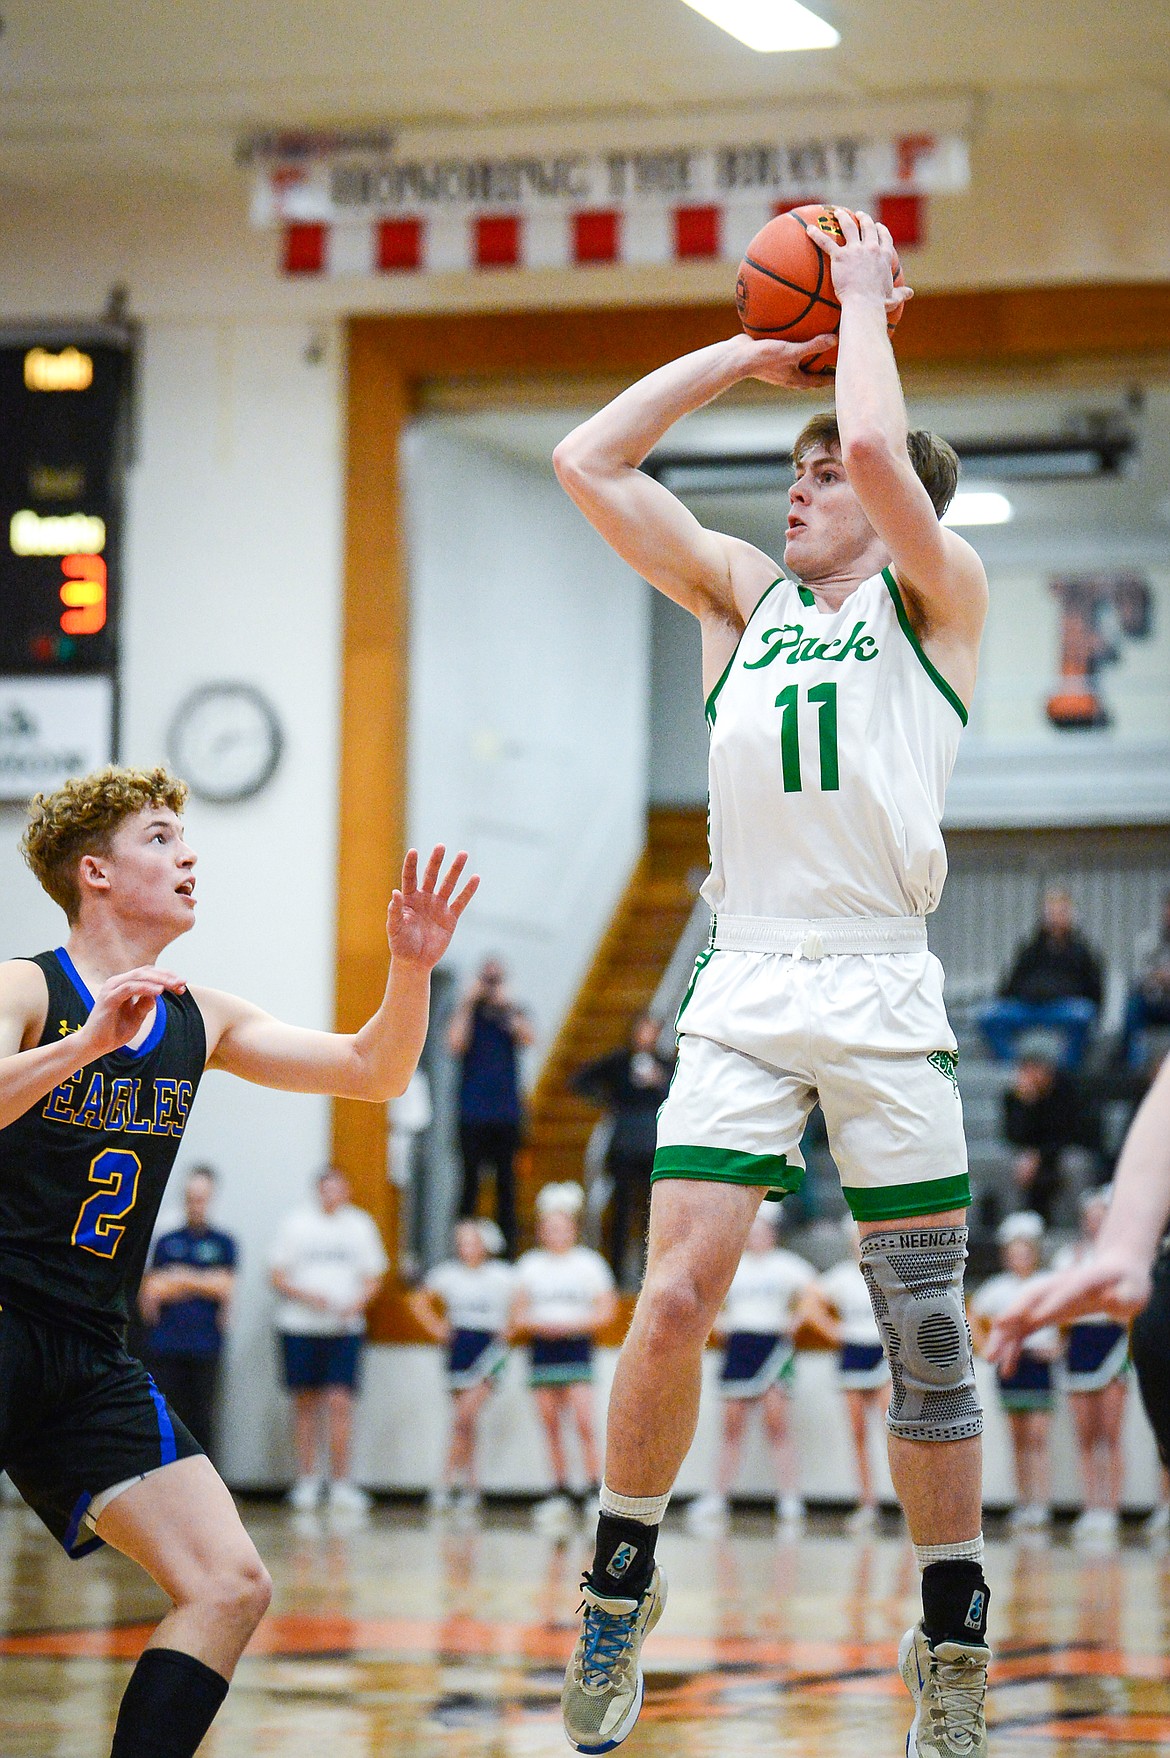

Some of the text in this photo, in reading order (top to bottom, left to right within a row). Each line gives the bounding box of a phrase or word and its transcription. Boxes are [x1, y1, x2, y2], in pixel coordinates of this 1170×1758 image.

[59, 553, 107, 635] 3
[743, 622, 879, 669] Pack
[774, 682, 839, 793] 11
[42, 1069, 193, 1137] EAGLES
[71, 1147, 142, 1260] 2
[900, 1232, 957, 1249] NEENCA
